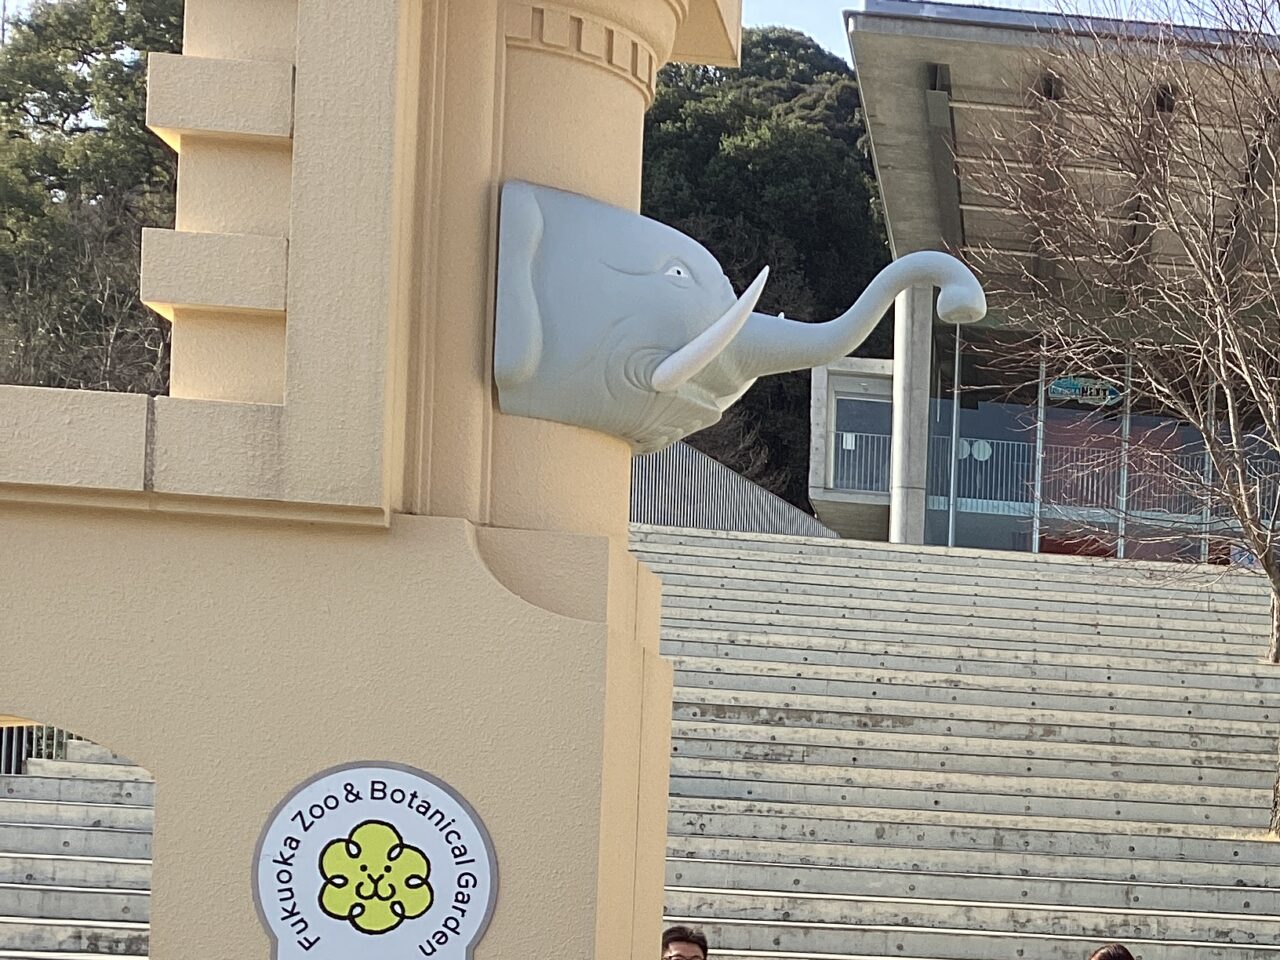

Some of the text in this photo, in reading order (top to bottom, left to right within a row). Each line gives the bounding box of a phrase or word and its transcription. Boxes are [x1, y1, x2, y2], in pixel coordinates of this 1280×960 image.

[272, 780, 477, 957] Fukuoka Zoo & Botanical Garden
